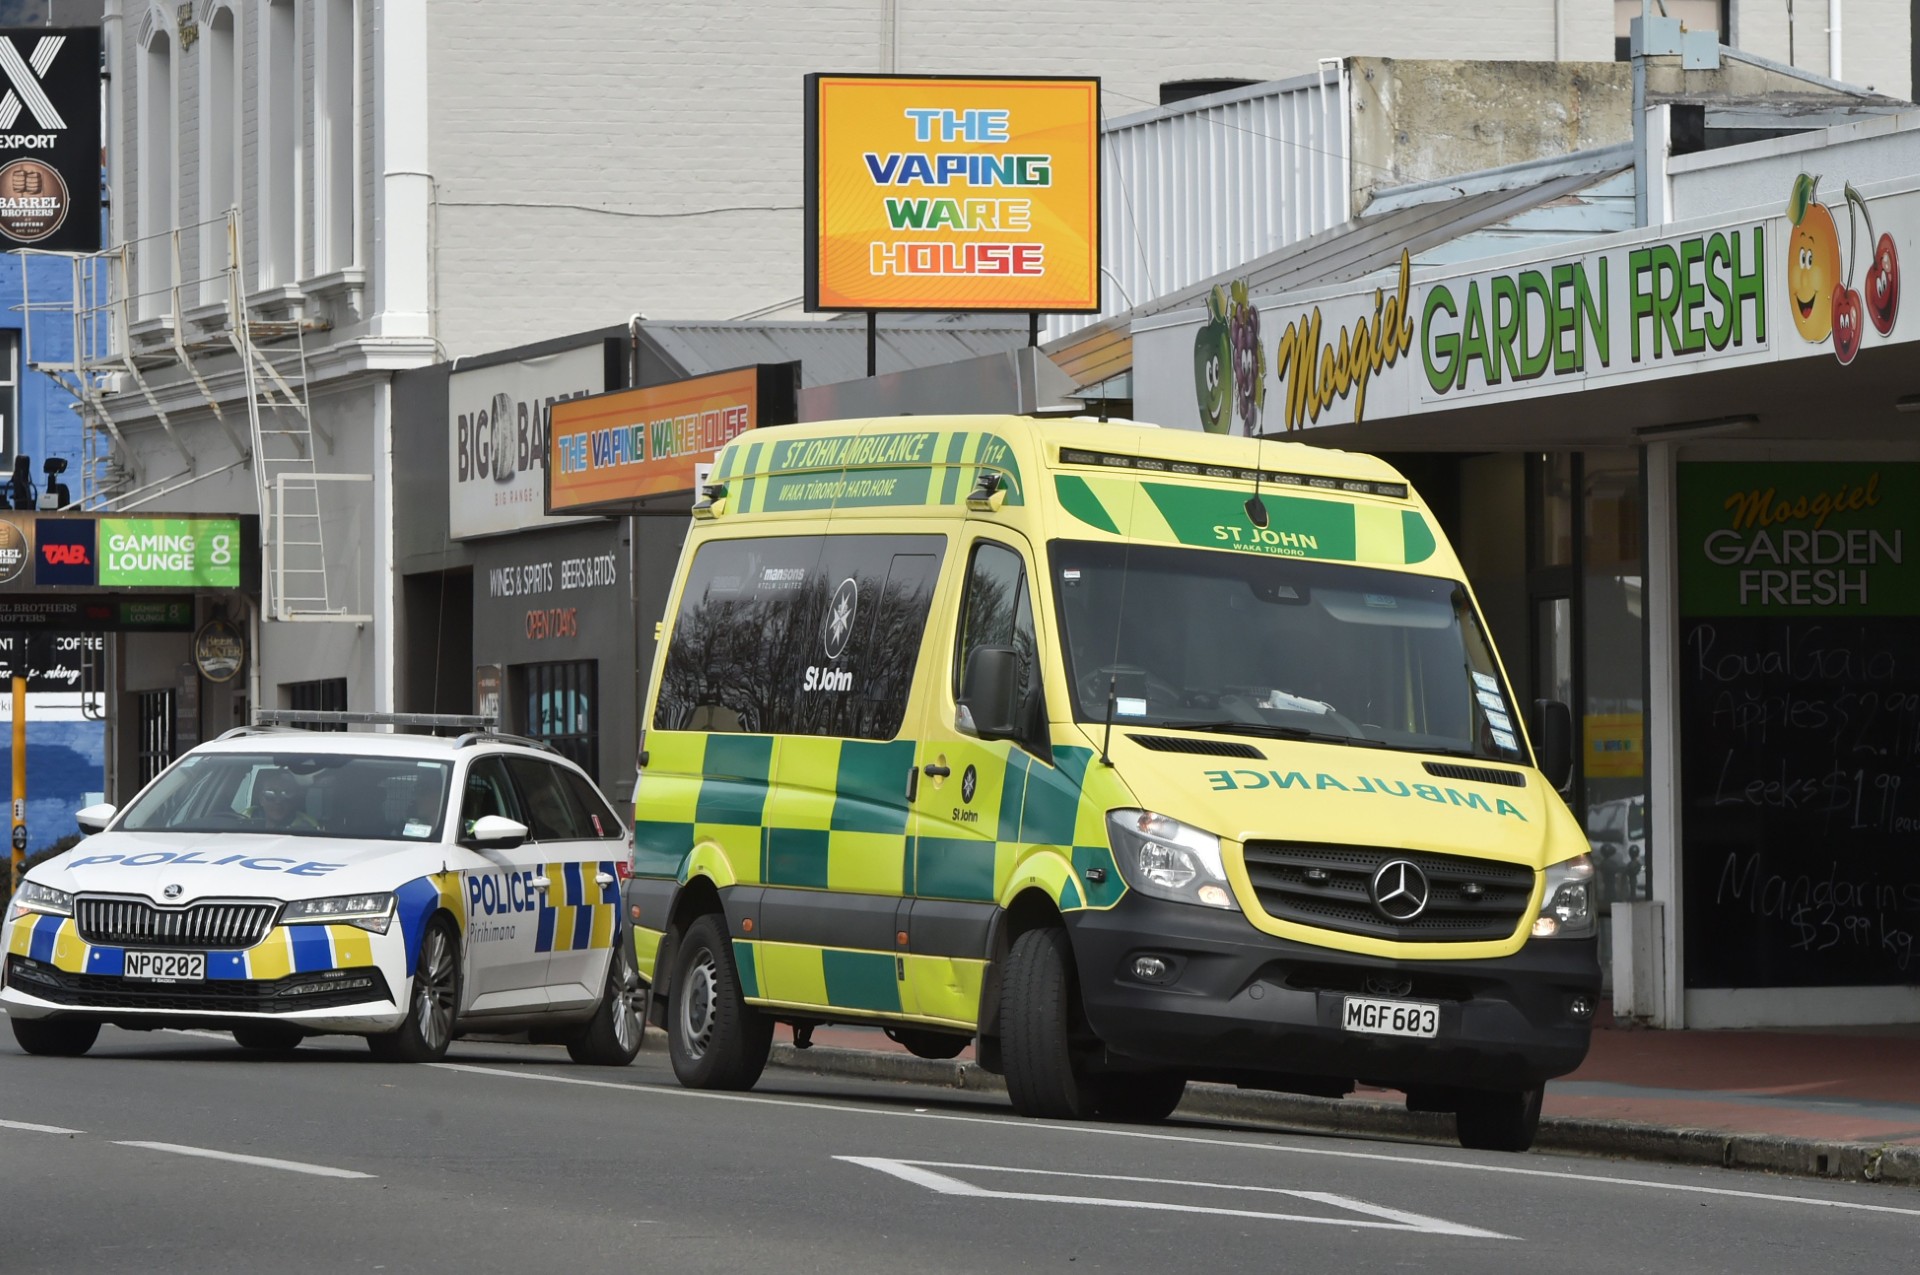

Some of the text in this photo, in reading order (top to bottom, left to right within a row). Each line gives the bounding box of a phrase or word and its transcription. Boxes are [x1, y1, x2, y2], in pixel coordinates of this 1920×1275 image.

[905, 108, 1009, 142] THE
[0, 134, 57, 148] EXPORT
[863, 152, 1051, 186] VAPING
[0, 197, 60, 209] BARREL
[1, 209, 54, 217] BROTHERS
[884, 198, 1032, 232] WARE
[870, 242, 1045, 276] HOUSE
[1277, 226, 1766, 433] Mosgiel GARDEN FRESH
[458, 410, 490, 482] BIG
[557, 433, 588, 474] THE
[591, 424, 645, 469] VAPING
[650, 404, 748, 461] WAREHOUSE
[782, 434, 929, 468] ST JOHN AMBULANCE
[779, 484, 805, 500] WAKA
[869, 479, 897, 496] HONE
[1724, 471, 1879, 530] Mosgiel
[109, 535, 195, 552] GAMING
[1213, 525, 1318, 549] ST JOHN
[1233, 543, 1262, 552] WAKA
[1704, 529, 1902, 565] GARDEN
[109, 553, 195, 571] LOUNGE
[561, 558, 585, 589] BEERS
[587, 557, 593, 587] &
[490, 562, 553, 598] WINES & SPIRITS
[1740, 569, 1868, 606] FRESH
[14, 603, 77, 612] BROTHERS
[525, 610, 549, 640] OPEN
[803, 666, 852, 691] St John
[1715, 748, 1818, 808] Leeks
[952, 808, 978, 822] St John
[65, 852, 349, 877] POLICE
[468, 870, 535, 916] POLICE
[470, 921, 515, 944] Pirihimana
[1879, 912, 1912, 970] kg
[127, 955, 202, 977] NPQ202
[1347, 1003, 1435, 1033] MGF603
